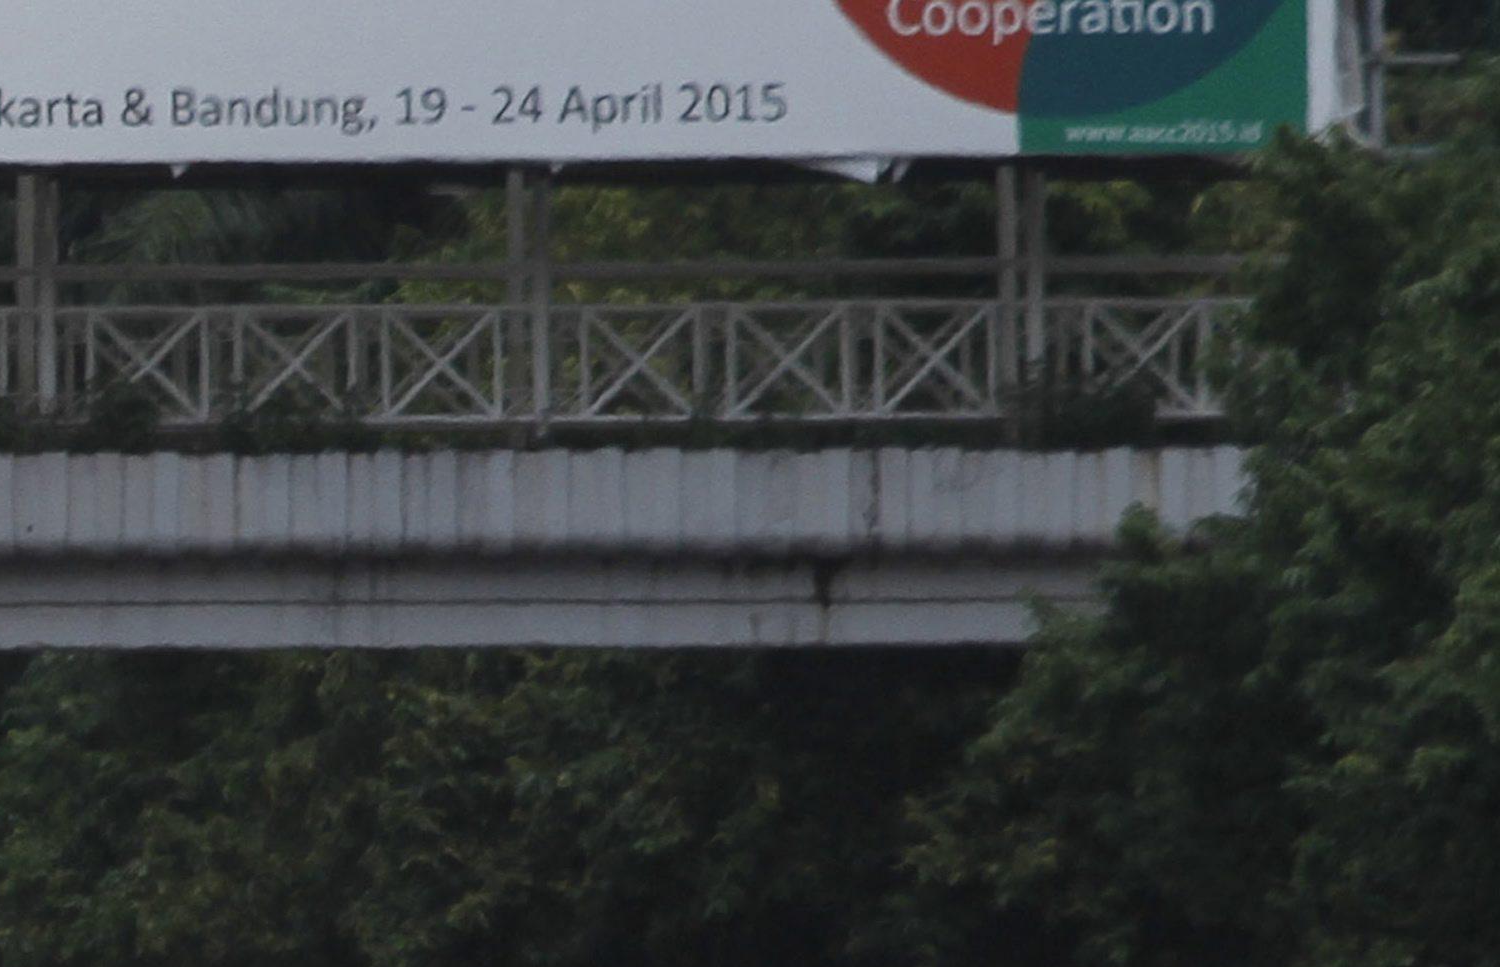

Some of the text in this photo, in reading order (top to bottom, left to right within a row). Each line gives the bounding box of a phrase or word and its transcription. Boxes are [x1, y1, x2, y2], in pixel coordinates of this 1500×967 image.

[886, 0, 1215, 46] Cooperation
[119, 87, 155, 128] &
[170, 85, 380, 138] Bandung,
[395, 85, 450, 127] 19
[490, 83, 546, 127] 24
[556, 81, 664, 135] April
[675, 78, 789, 126] 2015
